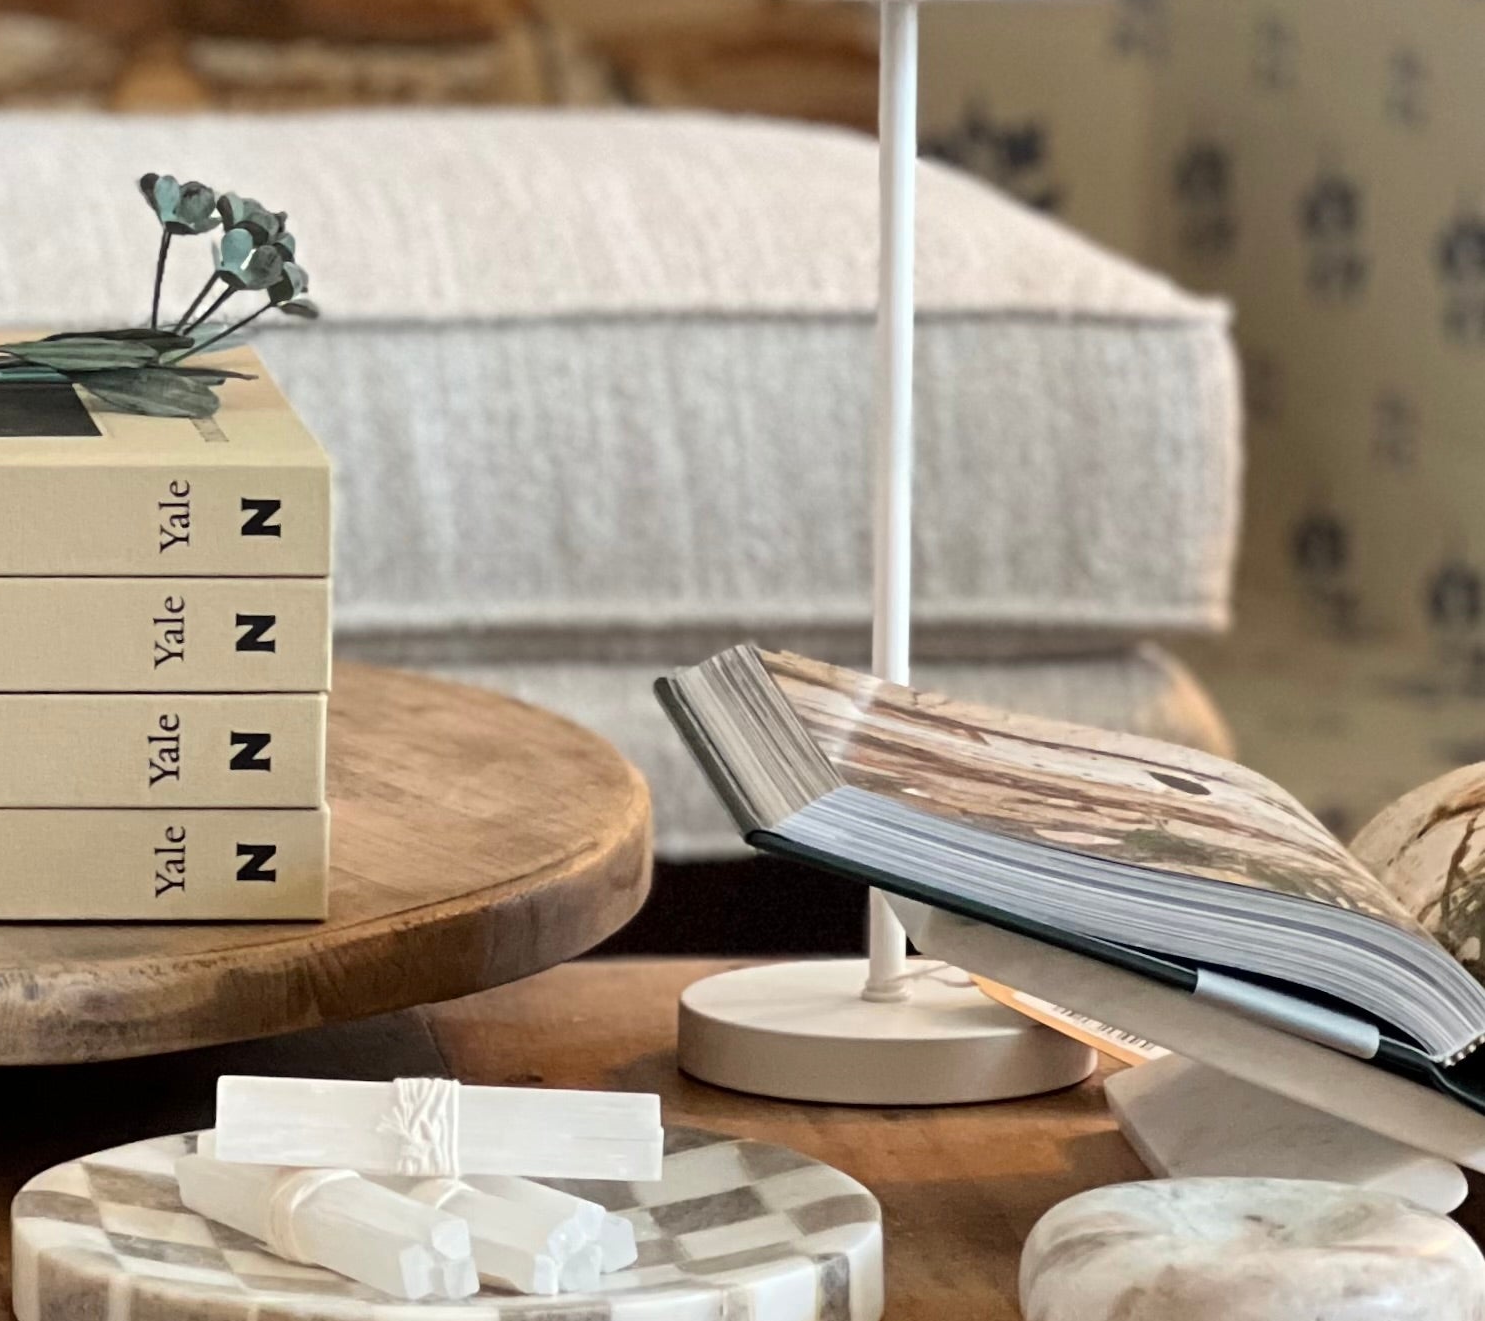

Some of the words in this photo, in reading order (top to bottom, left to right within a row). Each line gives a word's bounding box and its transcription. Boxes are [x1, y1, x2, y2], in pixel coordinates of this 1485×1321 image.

[157, 480, 191, 554] Yale
[152, 595, 186, 670] Yale
[146, 713, 181, 788] Yale
[153, 826, 186, 899] Yale
